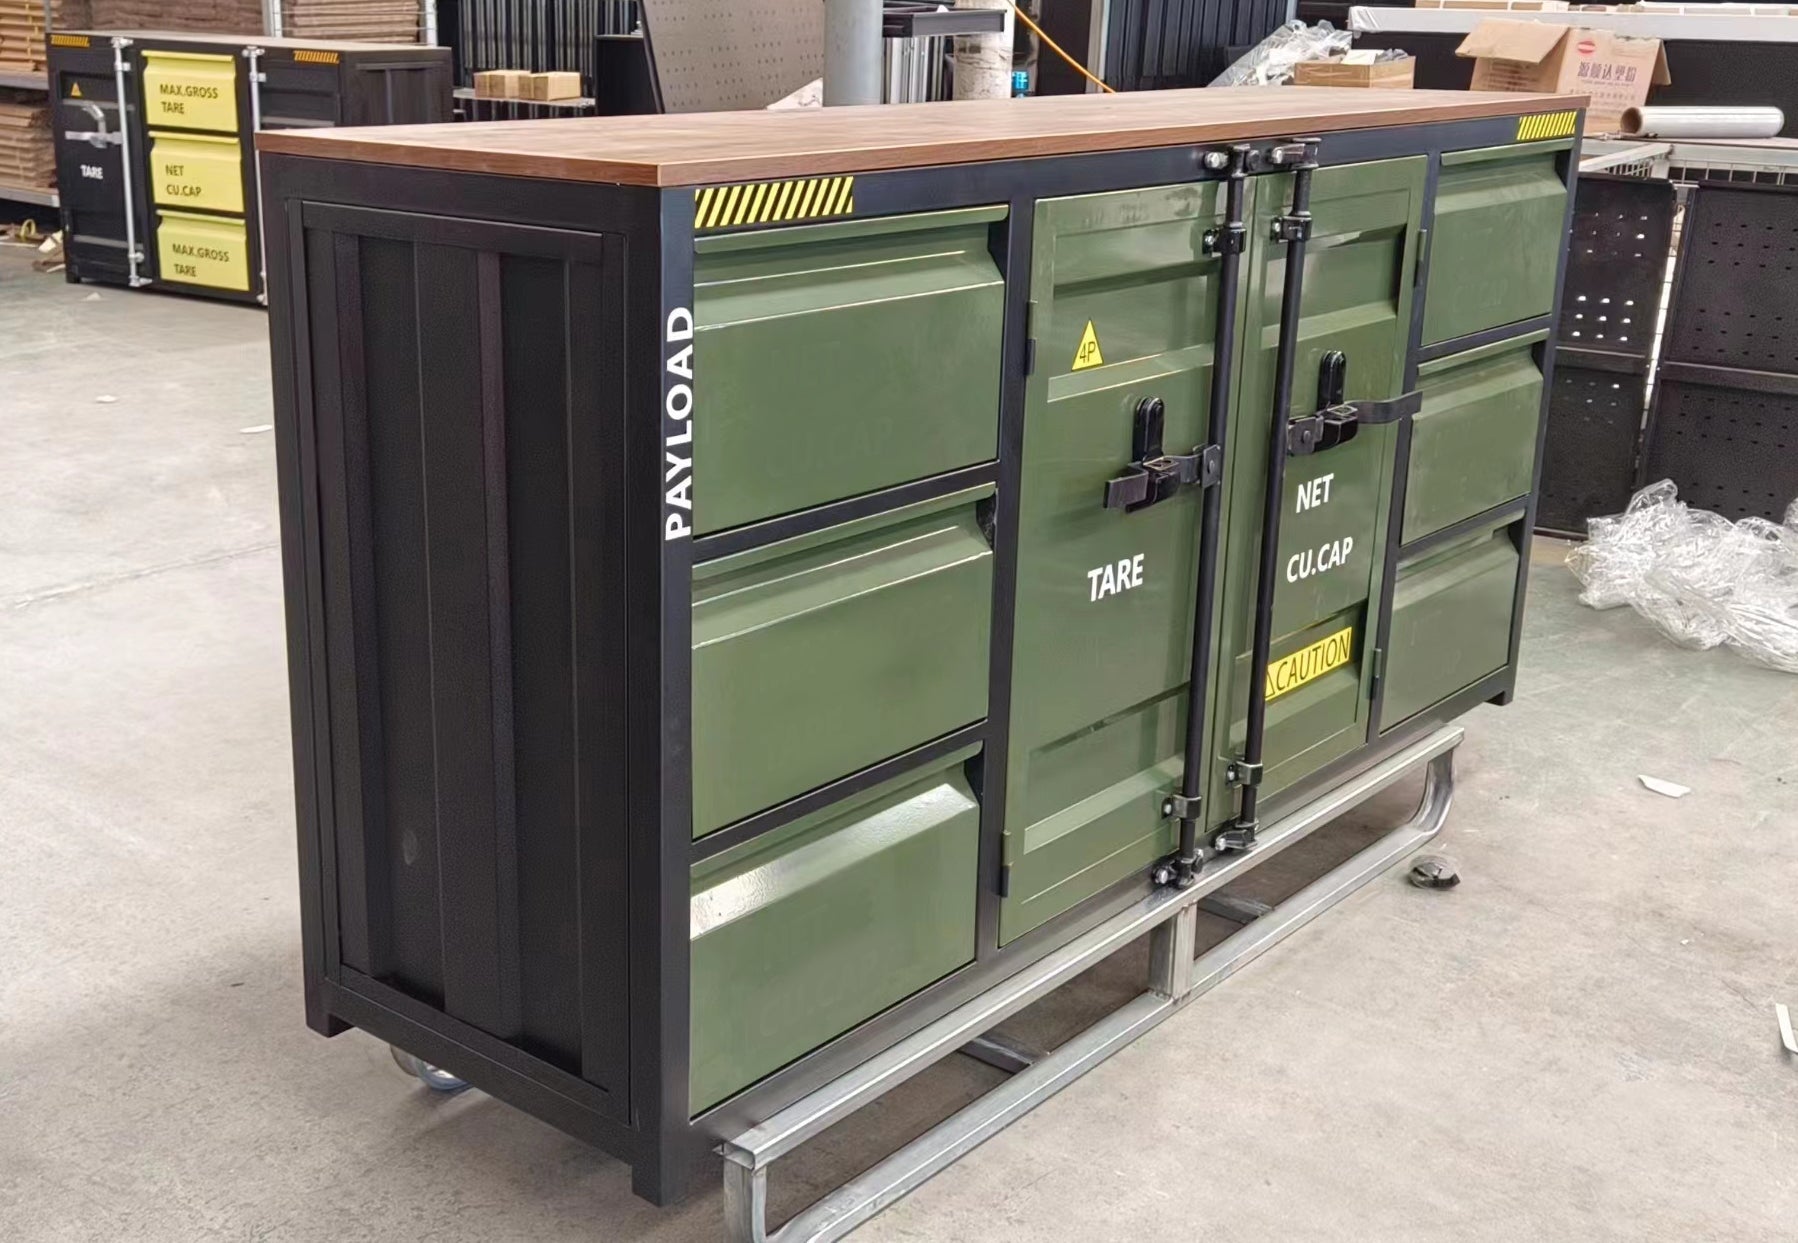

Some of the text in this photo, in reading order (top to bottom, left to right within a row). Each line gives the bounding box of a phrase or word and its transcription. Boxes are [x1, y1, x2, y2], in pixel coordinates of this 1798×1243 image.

[160, 83, 219, 99] MAX.GROSS
[161, 101, 185, 115] TARE
[80, 164, 103, 180] TARE
[165, 164, 184, 177] NET
[166, 184, 202, 197] CU.CAP
[172, 243, 230, 262] MAX.GROSS
[174, 263, 197, 277] TARE
[1078, 340, 1096, 364] 4P
[665, 306, 694, 541] PAYLOAD
[1295, 473, 1334, 513] NET
[1286, 536, 1354, 583] CU.CAP
[1087, 553, 1145, 602] TARE
[1276, 630, 1351, 694] CAUTION
